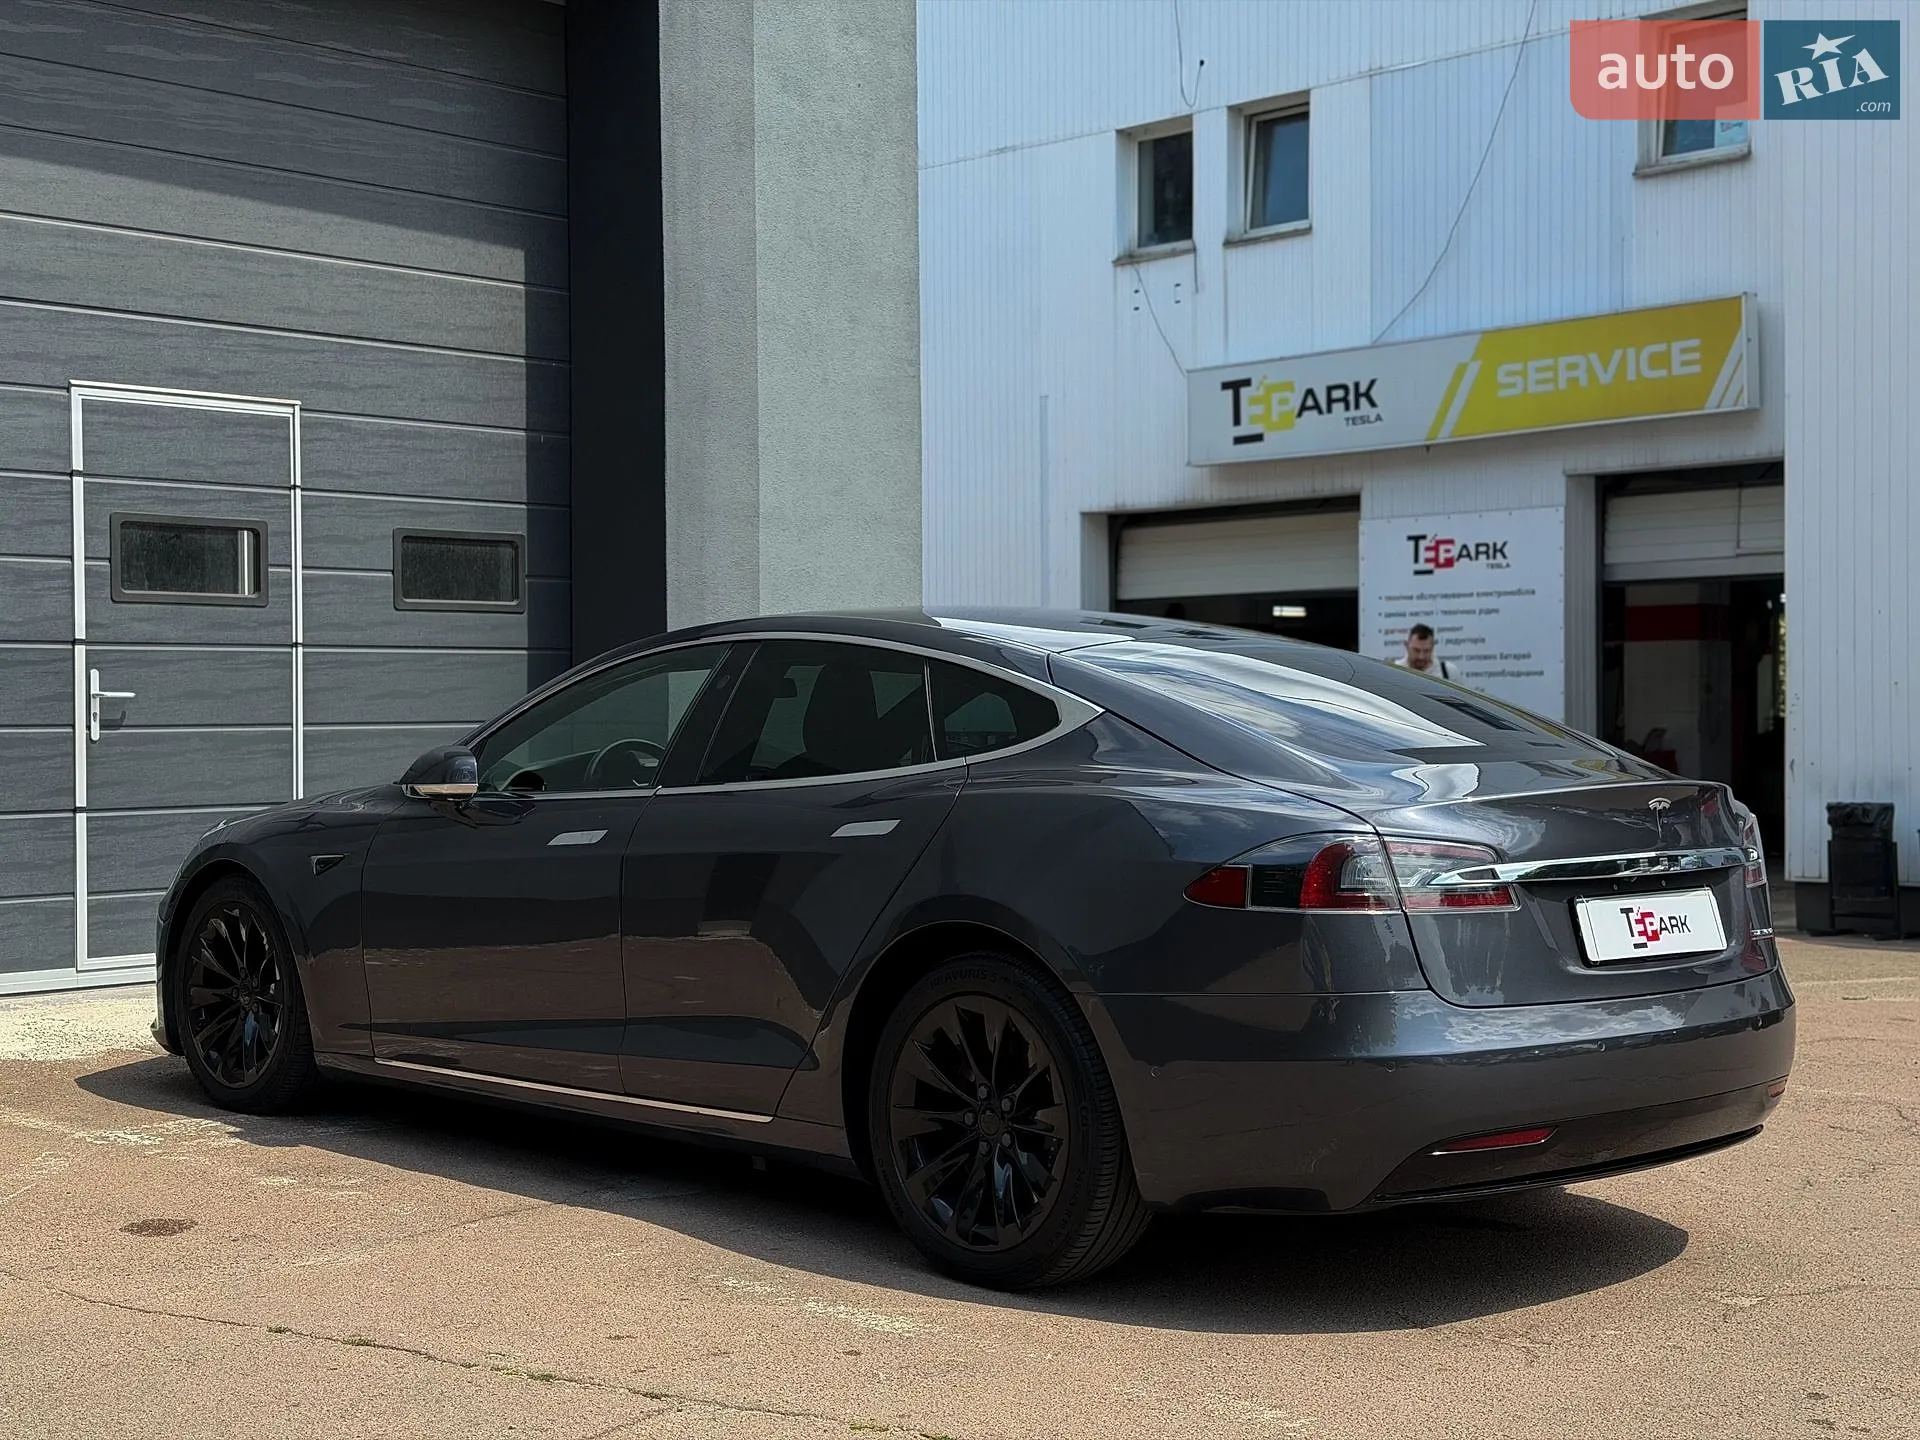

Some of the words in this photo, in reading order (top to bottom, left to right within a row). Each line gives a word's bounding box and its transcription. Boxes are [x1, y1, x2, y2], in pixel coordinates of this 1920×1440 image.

[1497, 338, 1701, 399] SERVICE
[1344, 413, 1383, 427] TESLA
[1486, 562, 1511, 570] TESLA
